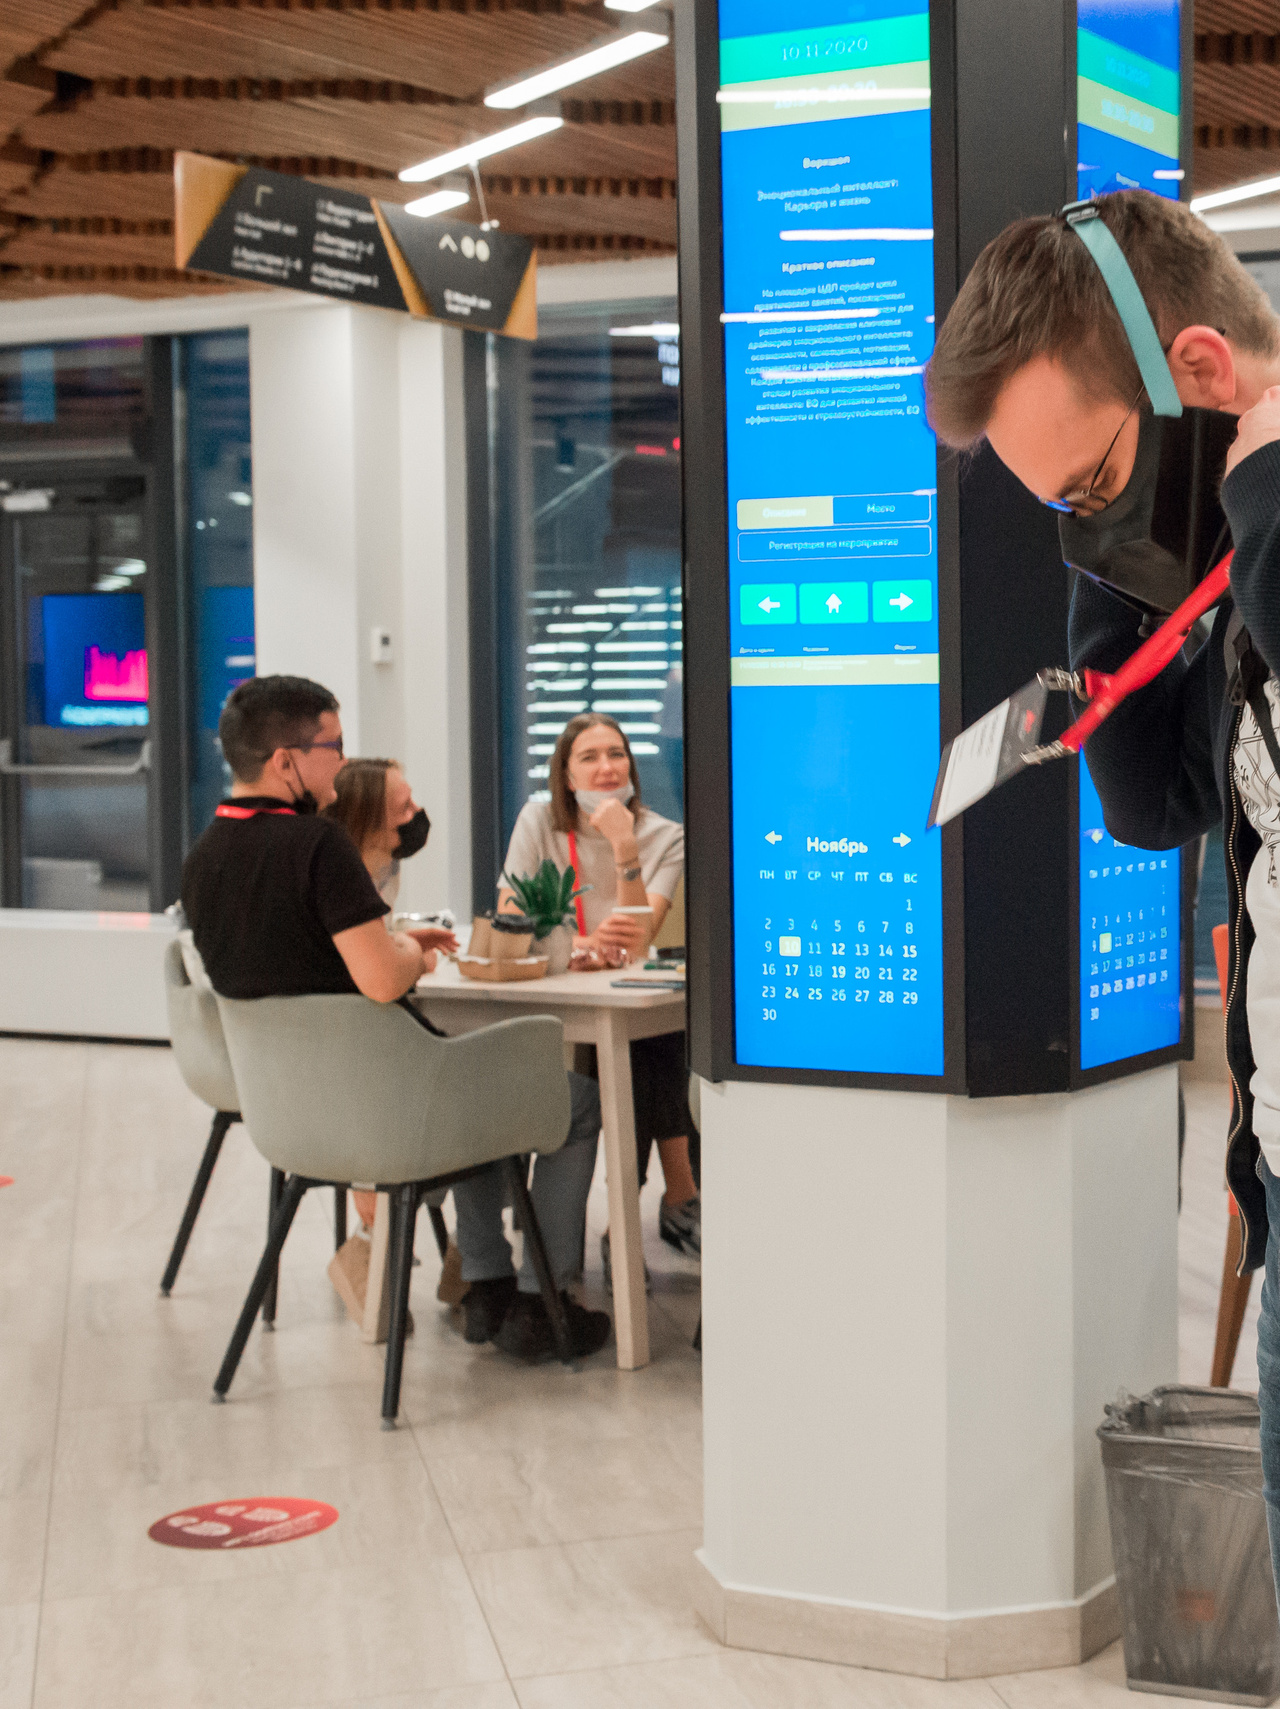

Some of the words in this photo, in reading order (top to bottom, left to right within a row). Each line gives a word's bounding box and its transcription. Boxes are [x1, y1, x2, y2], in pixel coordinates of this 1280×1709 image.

[784, 200, 828, 212] Карьера
[782, 262, 824, 274] Краткое
[867, 504, 895, 513] Место
[769, 540, 825, 550] Регистрация
[826, 540, 837, 548] на
[838, 538, 898, 548] мероприятие
[807, 836, 868, 858] Ноябрь
[759, 869, 775, 880] ПН
[784, 870, 798, 881] ВТ
[807, 870, 821, 881] СР
[831, 871, 845, 881] ЧТ
[854, 871, 870, 882] ПТ
[878, 872, 894, 883] СБ
[903, 873, 918, 884] ВС
[906, 898, 913, 912] 1
[764, 917, 772, 930] 2
[788, 918, 795, 931] 3
[810, 919, 818, 931] 4
[834, 919, 842, 933] 5
[857, 920, 866, 933] 6
[881, 920, 889, 934] 7
[905, 921, 914, 935] 8
[764, 940, 772, 953] 9
[784, 941, 799, 954] 10
[808, 942, 822, 955] 11
[831, 942, 846, 956] 12
[854, 943, 869, 956] 13
[878, 944, 893, 957] 14
[902, 944, 918, 959] 15
[762, 963, 776, 976] 16
[785, 963, 799, 977] 17
[808, 965, 823, 978] 18
[831, 965, 847, 979] 19
[854, 966, 870, 980] 20
[878, 967, 894, 981] 21
[902, 968, 918, 982] 22
[761, 985, 776, 998] 23
[784, 986, 800, 1000] 24
[807, 987, 823, 1001] 25
[831, 988, 847, 1002] 26
[854, 989, 870, 1003] 27
[878, 990, 895, 1004] 28
[902, 991, 919, 1005] 29
[762, 1007, 777, 1021] 30
